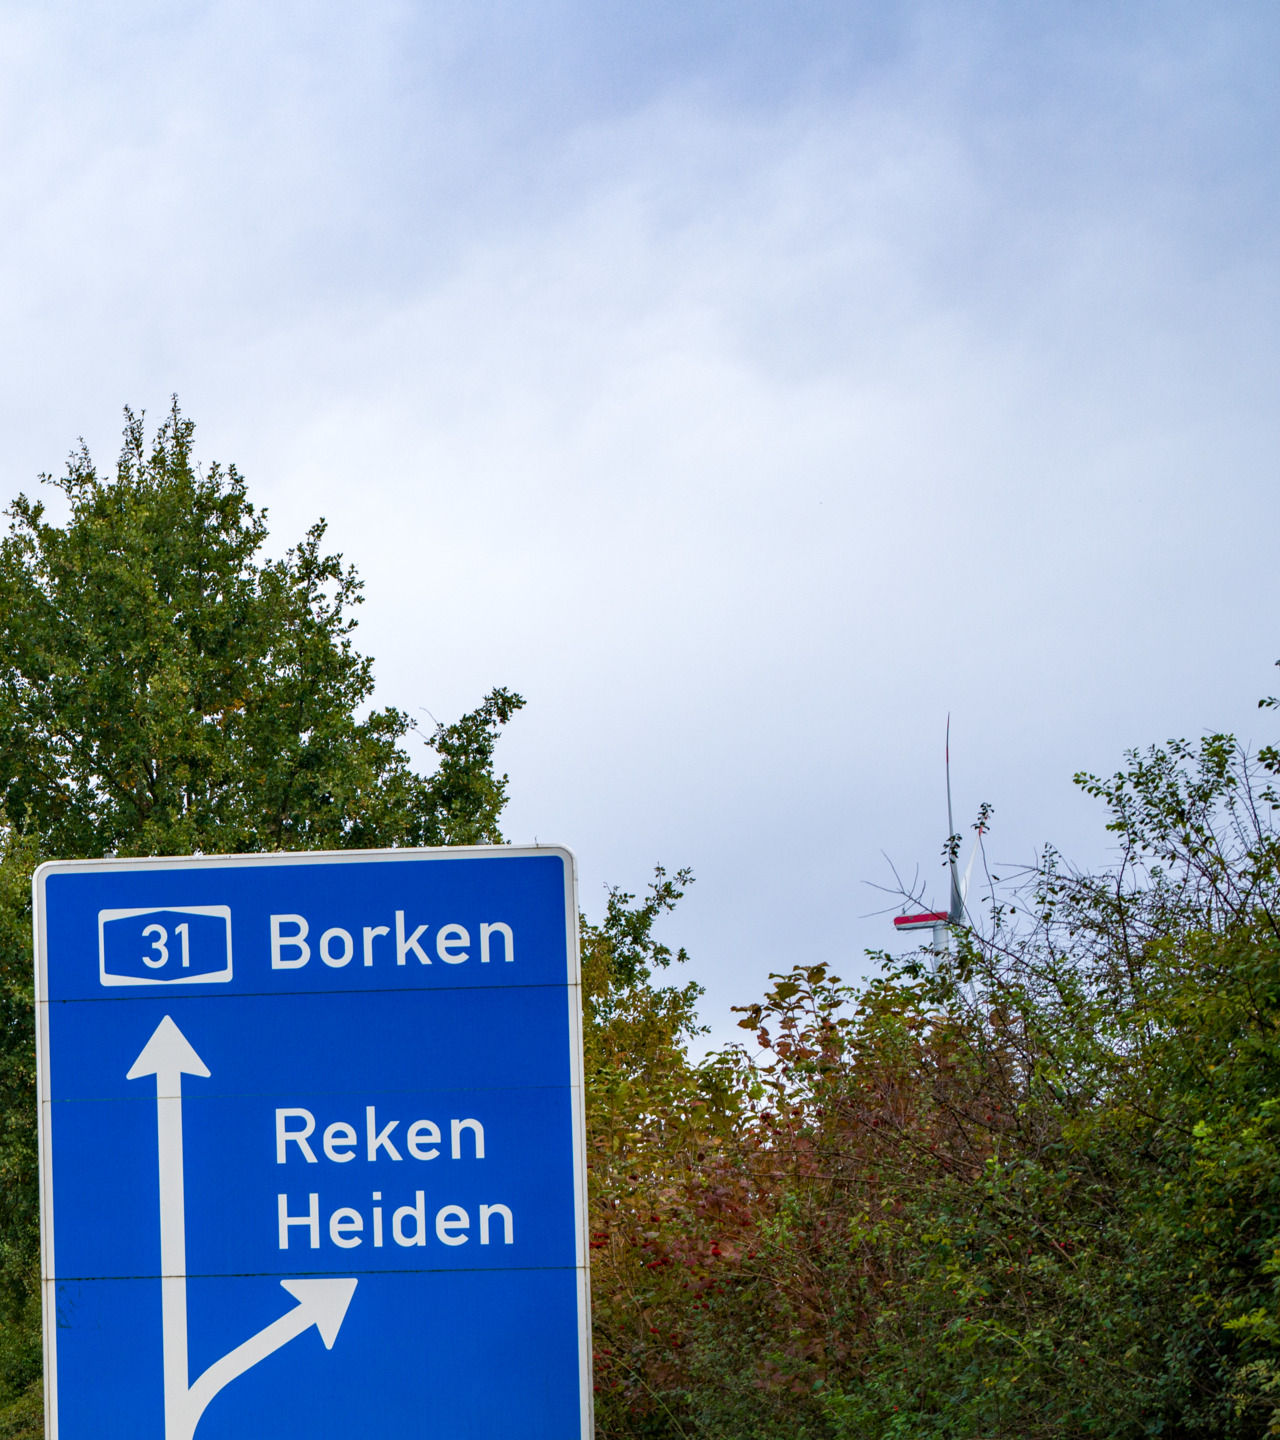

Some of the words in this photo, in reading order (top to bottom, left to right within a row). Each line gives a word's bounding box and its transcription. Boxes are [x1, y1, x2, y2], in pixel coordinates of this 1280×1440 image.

[142, 923, 190, 969] 31
[270, 910, 514, 970] Borken
[276, 1105, 485, 1164] Reken
[277, 1190, 514, 1250] Heiden
